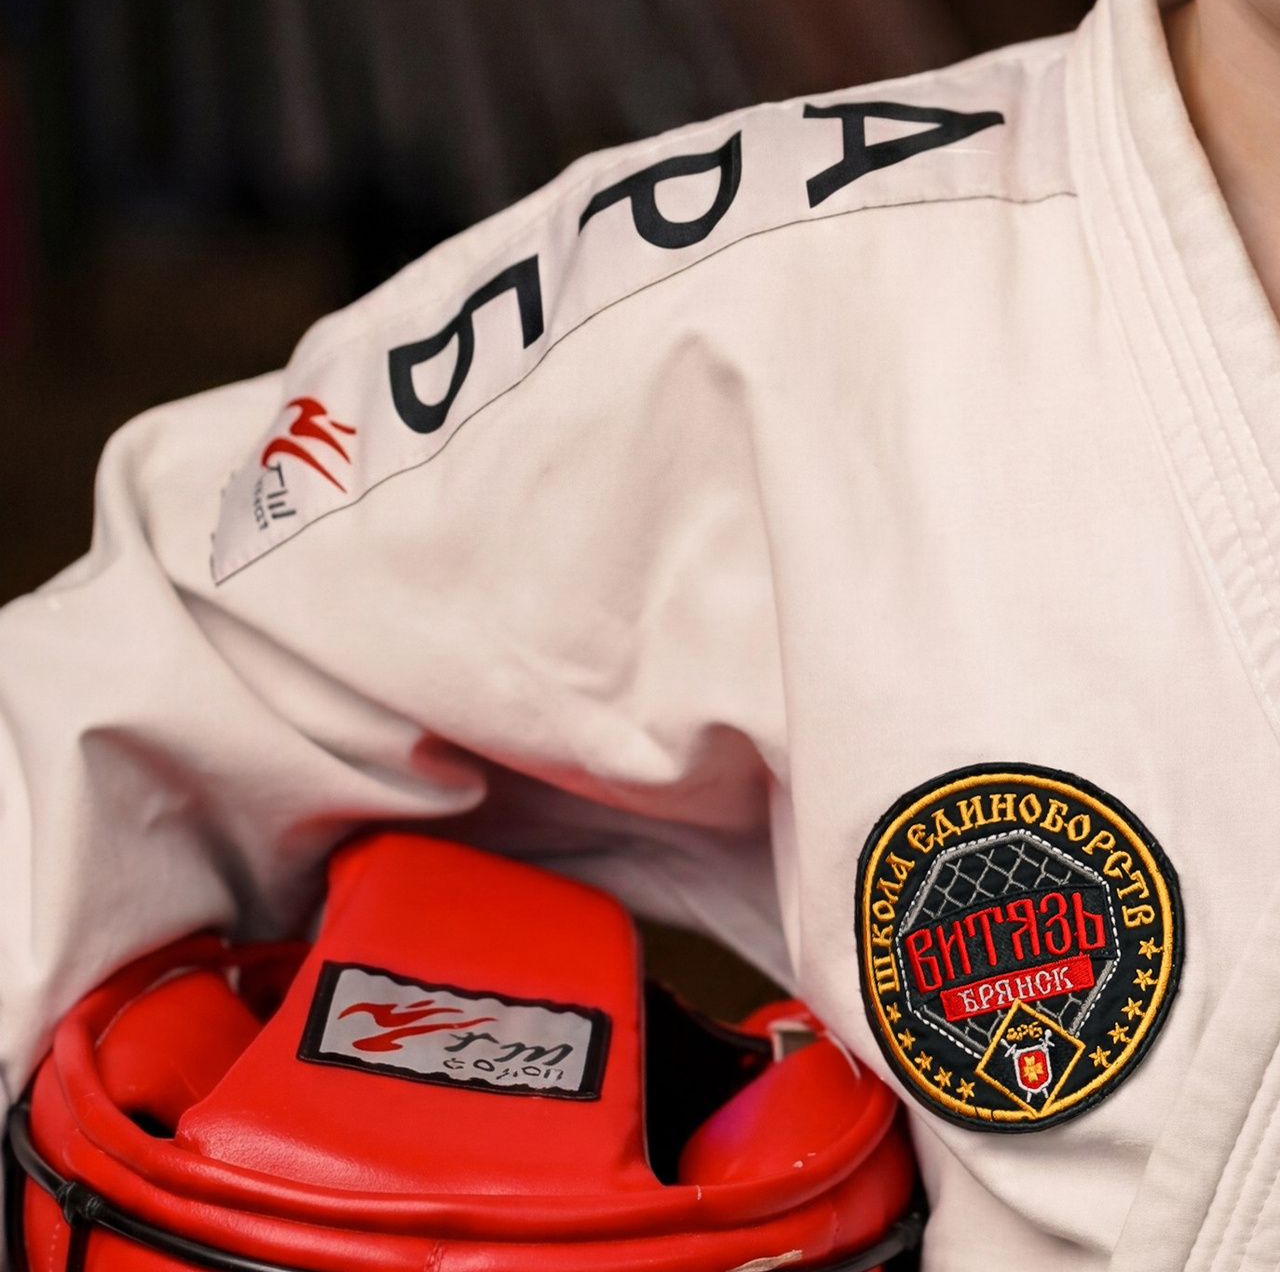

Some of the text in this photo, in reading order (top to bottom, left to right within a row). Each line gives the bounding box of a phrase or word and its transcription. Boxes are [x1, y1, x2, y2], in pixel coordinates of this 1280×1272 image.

[388, 101, 1005, 434] АРБ
[872, 792, 1156, 994] ШКОЛА ЕДИНОБОРСТВ
[905, 891, 1107, 995] ВИТЯЗЬ
[958, 966, 1075, 1014] БРЯНСК
